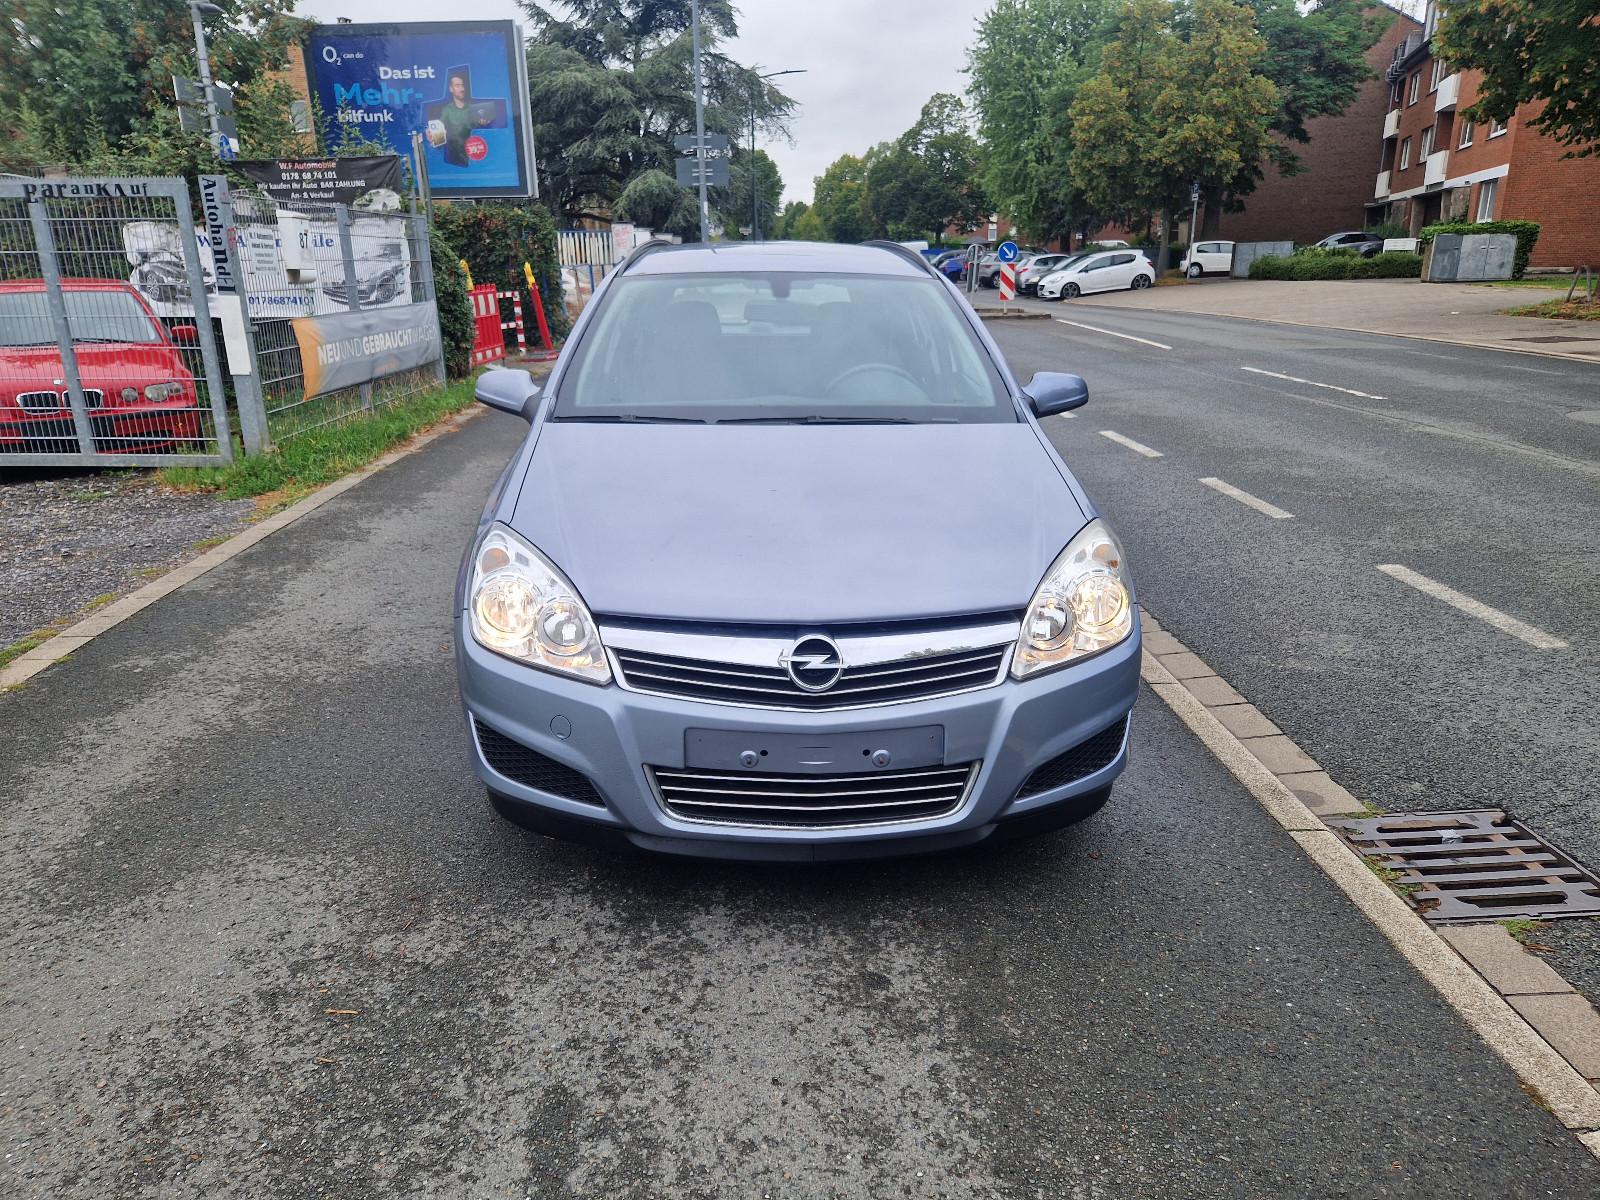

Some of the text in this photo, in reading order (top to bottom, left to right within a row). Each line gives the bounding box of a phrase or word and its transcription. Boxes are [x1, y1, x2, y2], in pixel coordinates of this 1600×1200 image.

[379, 65, 435, 80] Das ist
[333, 81, 423, 106] Mehr-
[337, 109, 394, 123] bilfunk
[281, 172, 300, 180] 0178
[312, 171, 323, 179] 74
[324, 170, 337, 179] 101
[256, 179, 366, 190] Wir kaufen Ihr Auto BAR ZAHLUNG
[302, 191, 309, 199] &
[309, 190, 335, 199] Verkauf
[299, 232, 308, 249] 87
